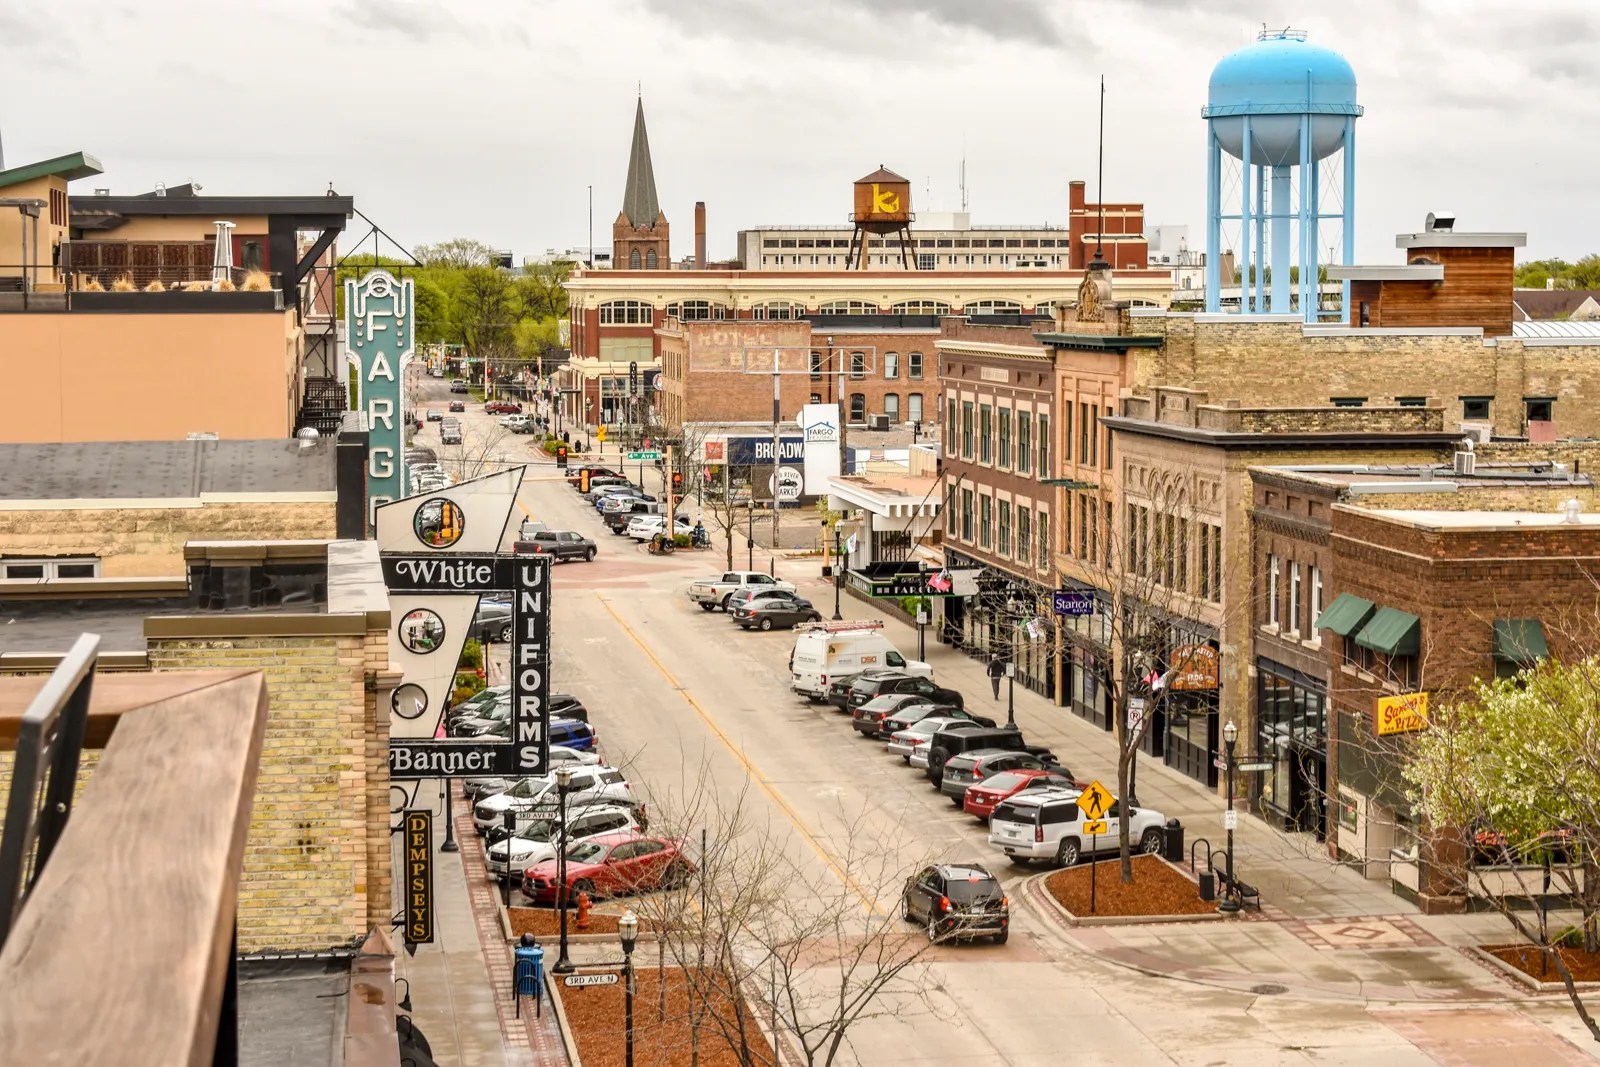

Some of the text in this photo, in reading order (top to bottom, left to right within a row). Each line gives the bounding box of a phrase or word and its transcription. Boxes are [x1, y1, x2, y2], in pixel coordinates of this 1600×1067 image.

[395, 560, 492, 588] White
[519, 565, 542, 768] UNIFORMS
[1187, 674, 1204, 682] FROG
[390, 748, 497, 774] Banner
[411, 819, 427, 938] DEMPSEYS
[570, 974, 614, 985] 3RD AVE N
